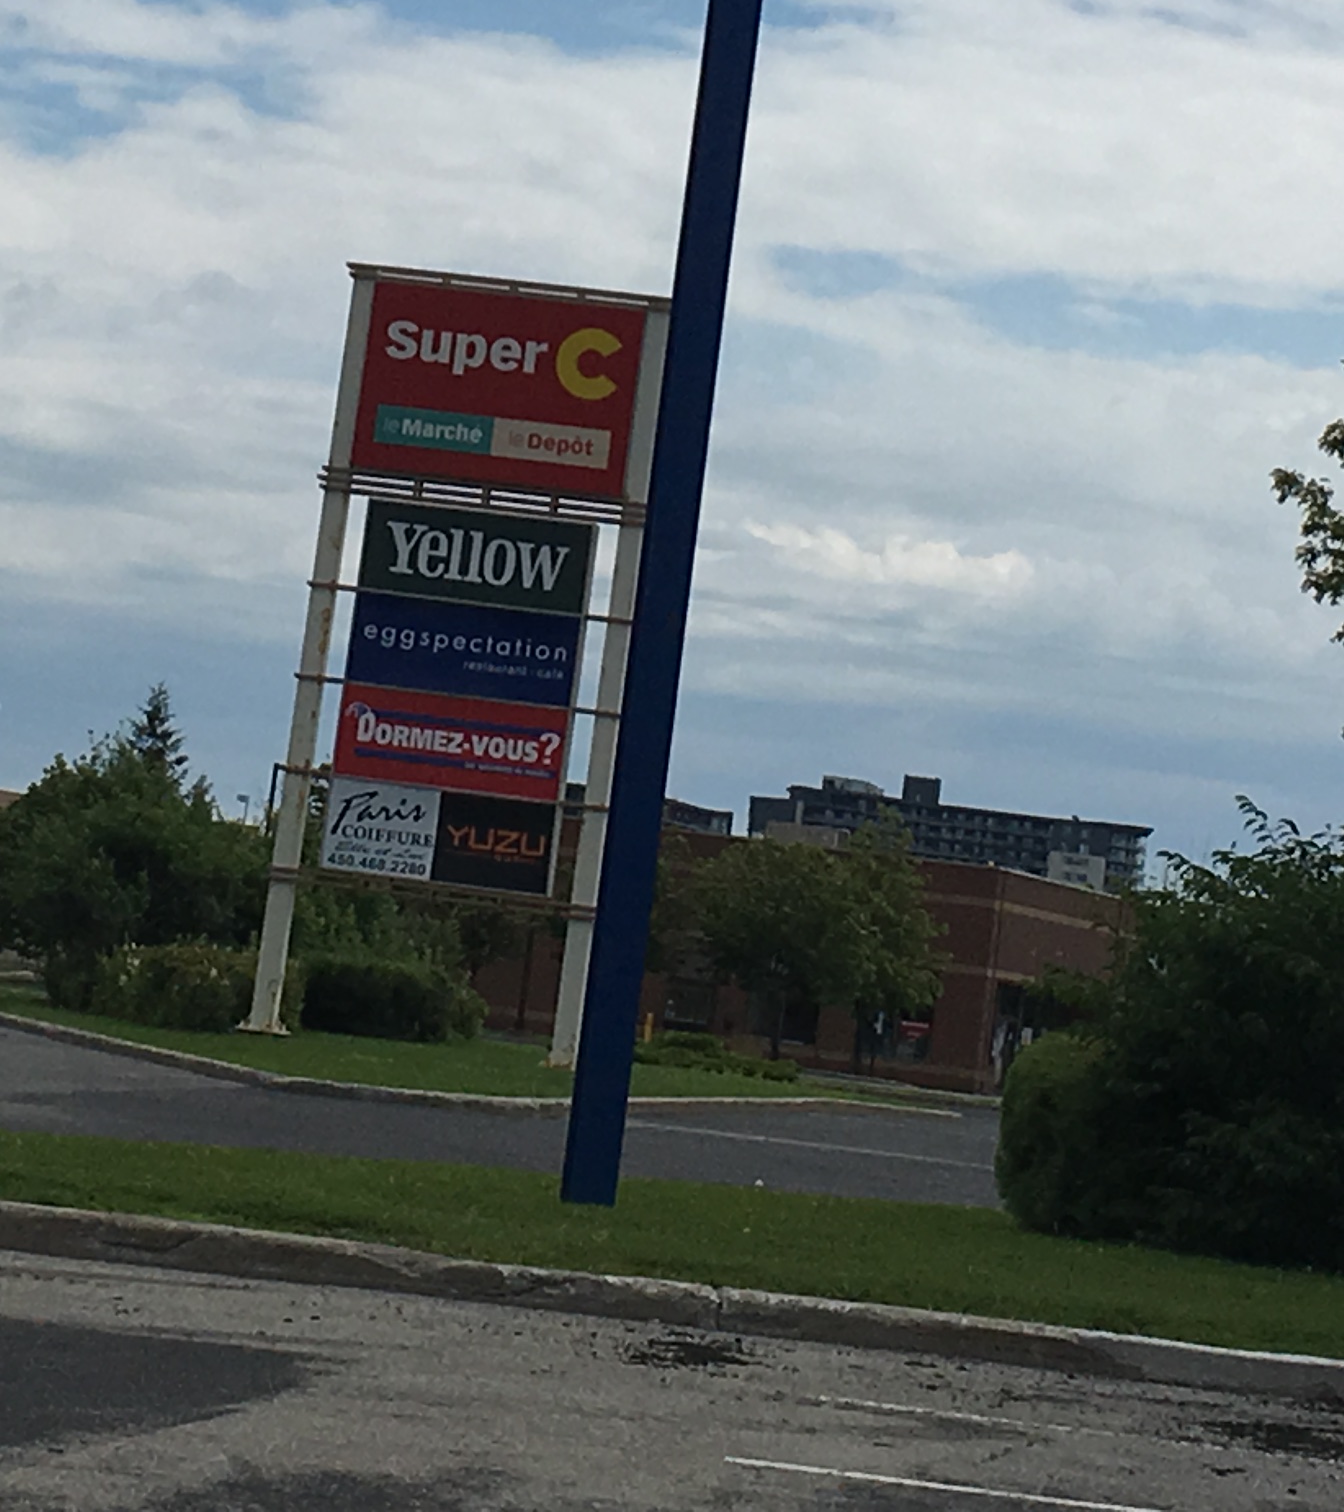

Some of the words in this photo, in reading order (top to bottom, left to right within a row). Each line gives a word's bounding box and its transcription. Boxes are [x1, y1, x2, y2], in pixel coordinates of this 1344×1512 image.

[386, 320, 548, 375] Super
[556, 328, 622, 400] C
[387, 521, 570, 591] Yellow
[364, 623, 567, 662] eggspectation
[331, 790, 427, 834] Paris
[341, 824, 434, 847] COIFFURE
[447, 825, 545, 856] YUZU
